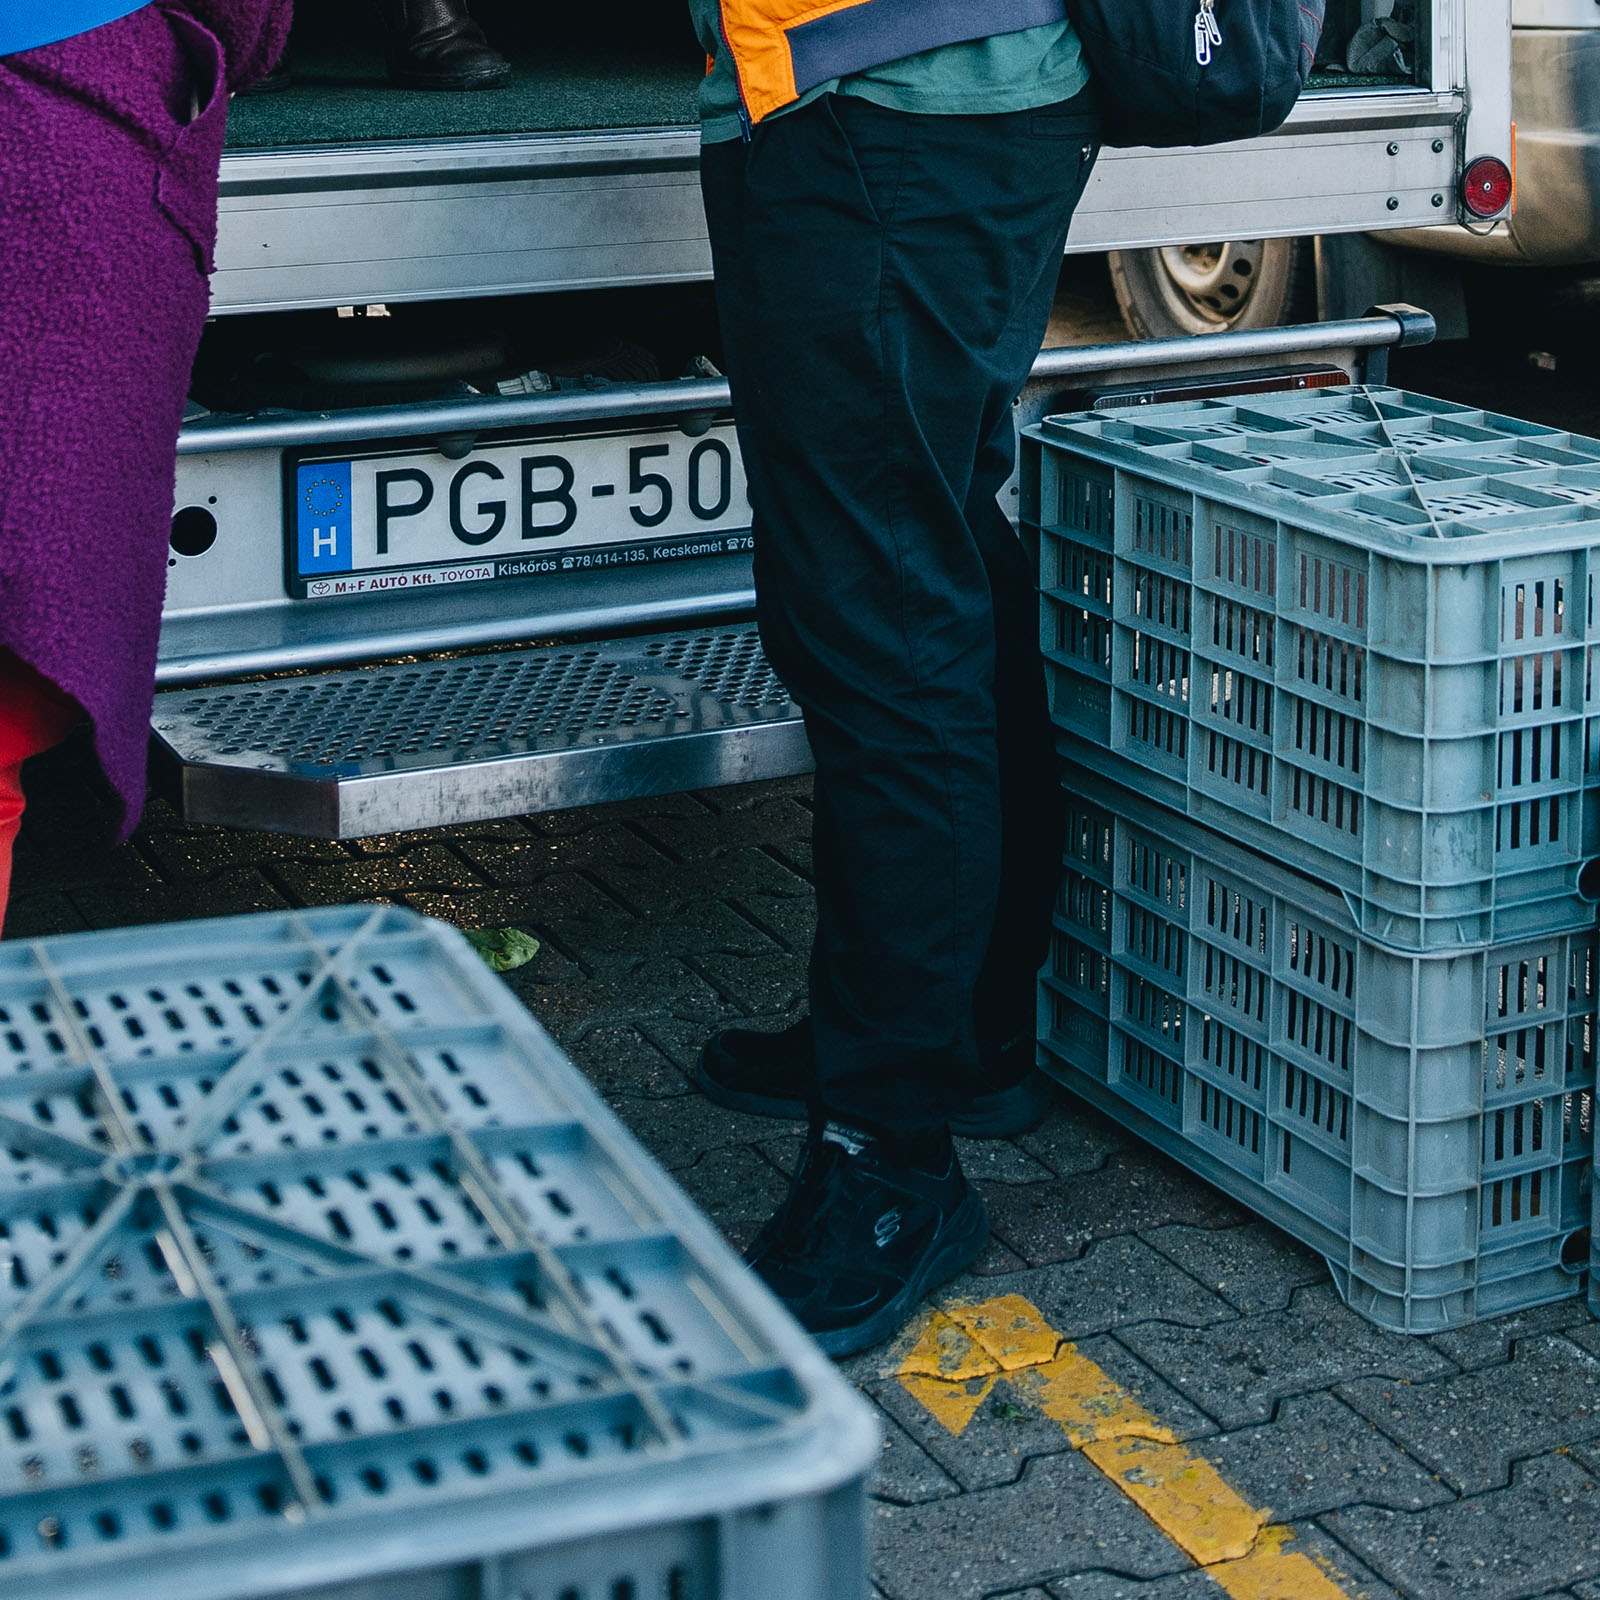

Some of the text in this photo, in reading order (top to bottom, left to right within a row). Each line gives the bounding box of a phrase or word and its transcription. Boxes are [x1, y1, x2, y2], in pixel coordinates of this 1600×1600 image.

[375, 438, 733, 555] PGB-50
[313, 526, 338, 558] H
[369, 573, 408, 590] AUTÓ
[412, 573, 436, 586] Kft.
[440, 567, 491, 582] TOYOTA
[498, 560, 557, 577] Kiskőrös
[653, 540, 723, 560] Kecskemét
